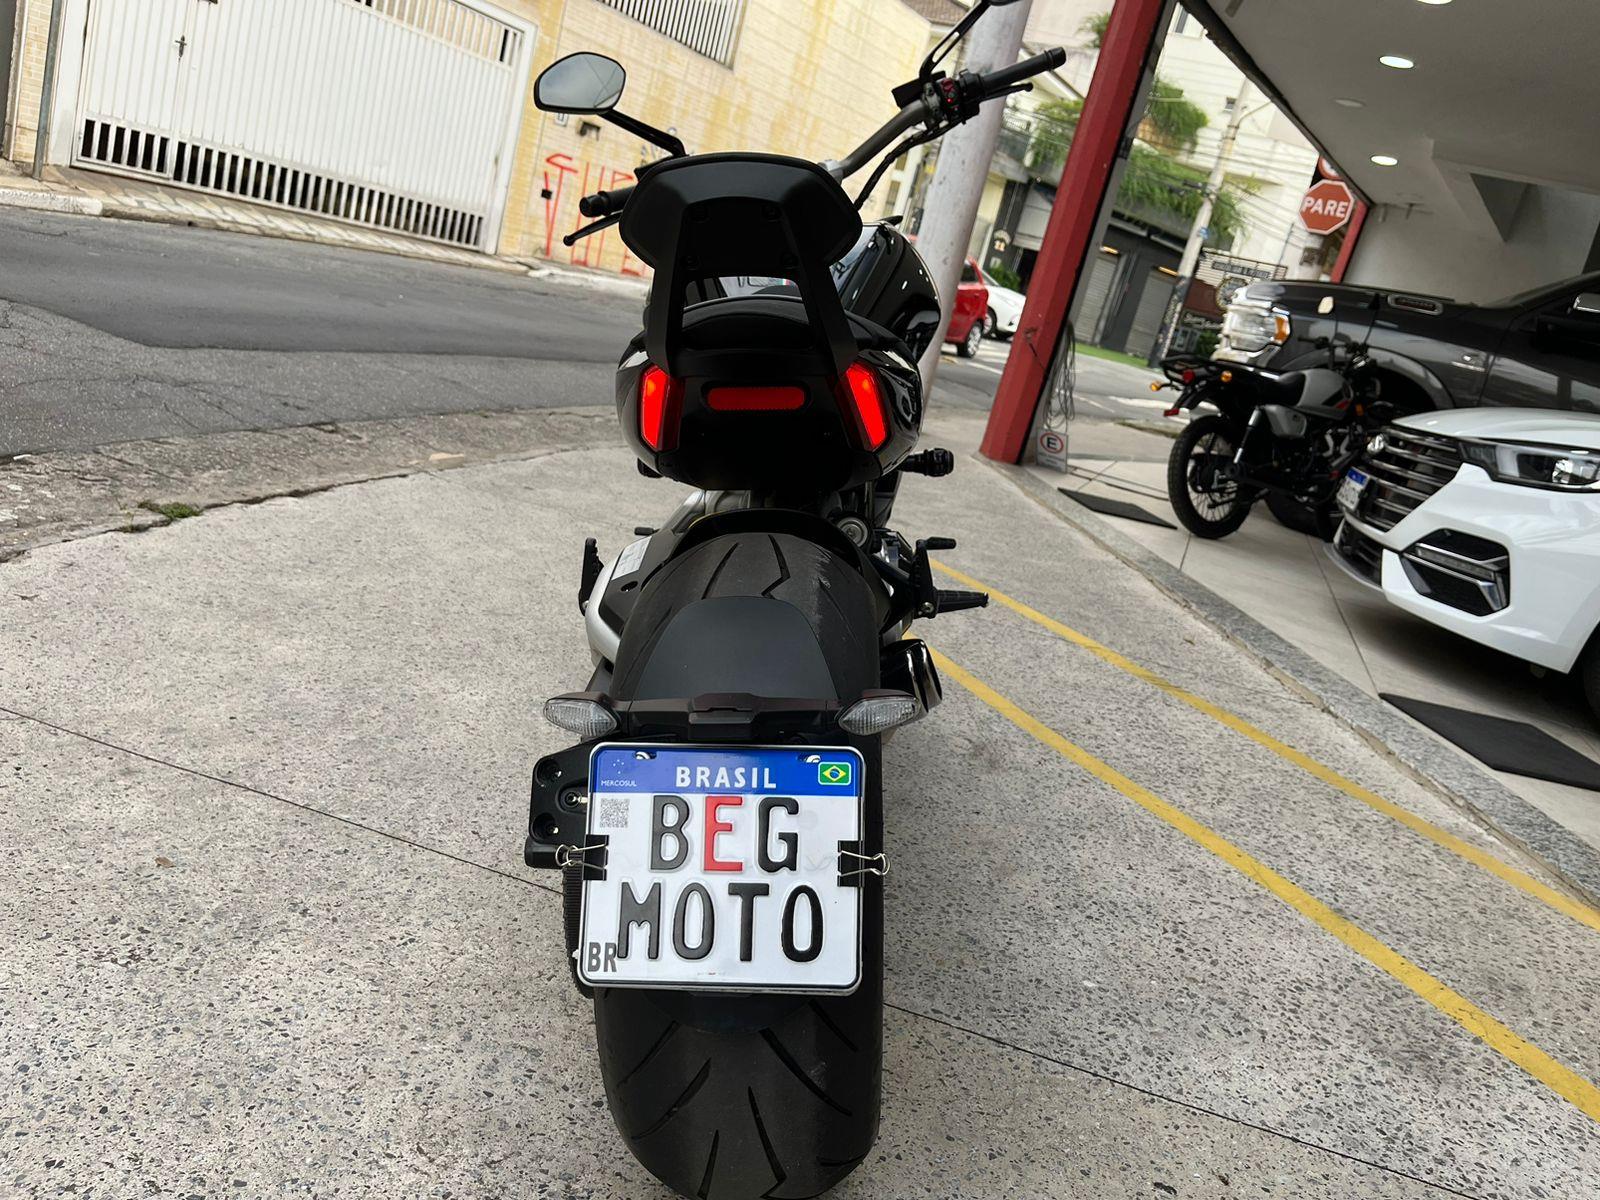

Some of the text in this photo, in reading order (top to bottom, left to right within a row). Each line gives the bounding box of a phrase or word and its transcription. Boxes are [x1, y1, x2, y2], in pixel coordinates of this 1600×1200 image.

[1301, 196, 1349, 219] PARE
[1047, 436, 1058, 451] E
[675, 766, 777, 789] BRASIL
[650, 795, 800, 873] BEG
[616, 881, 825, 963] MOTO
[587, 942, 618, 973] BR
